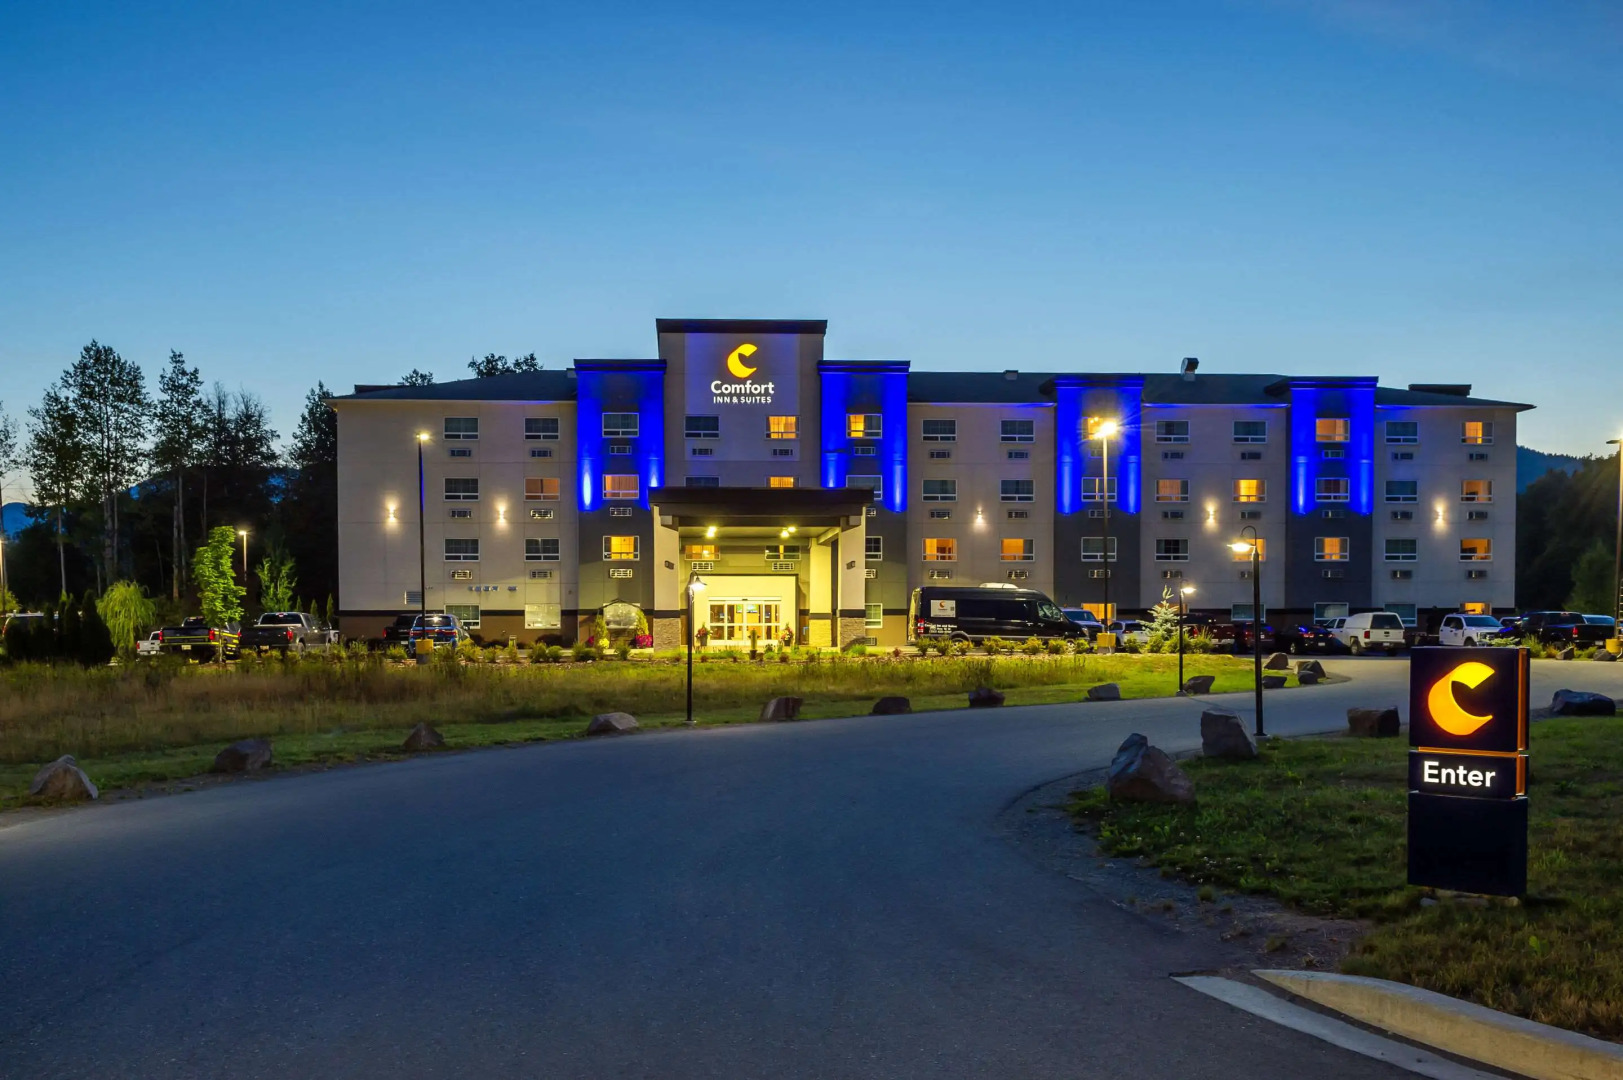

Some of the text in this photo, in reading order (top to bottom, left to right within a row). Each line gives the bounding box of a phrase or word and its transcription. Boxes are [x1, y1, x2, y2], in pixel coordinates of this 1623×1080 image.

[711, 380, 774, 394] Comfort
[713, 396, 772, 404] INN & SUITES
[1423, 761, 1496, 787] Enter
